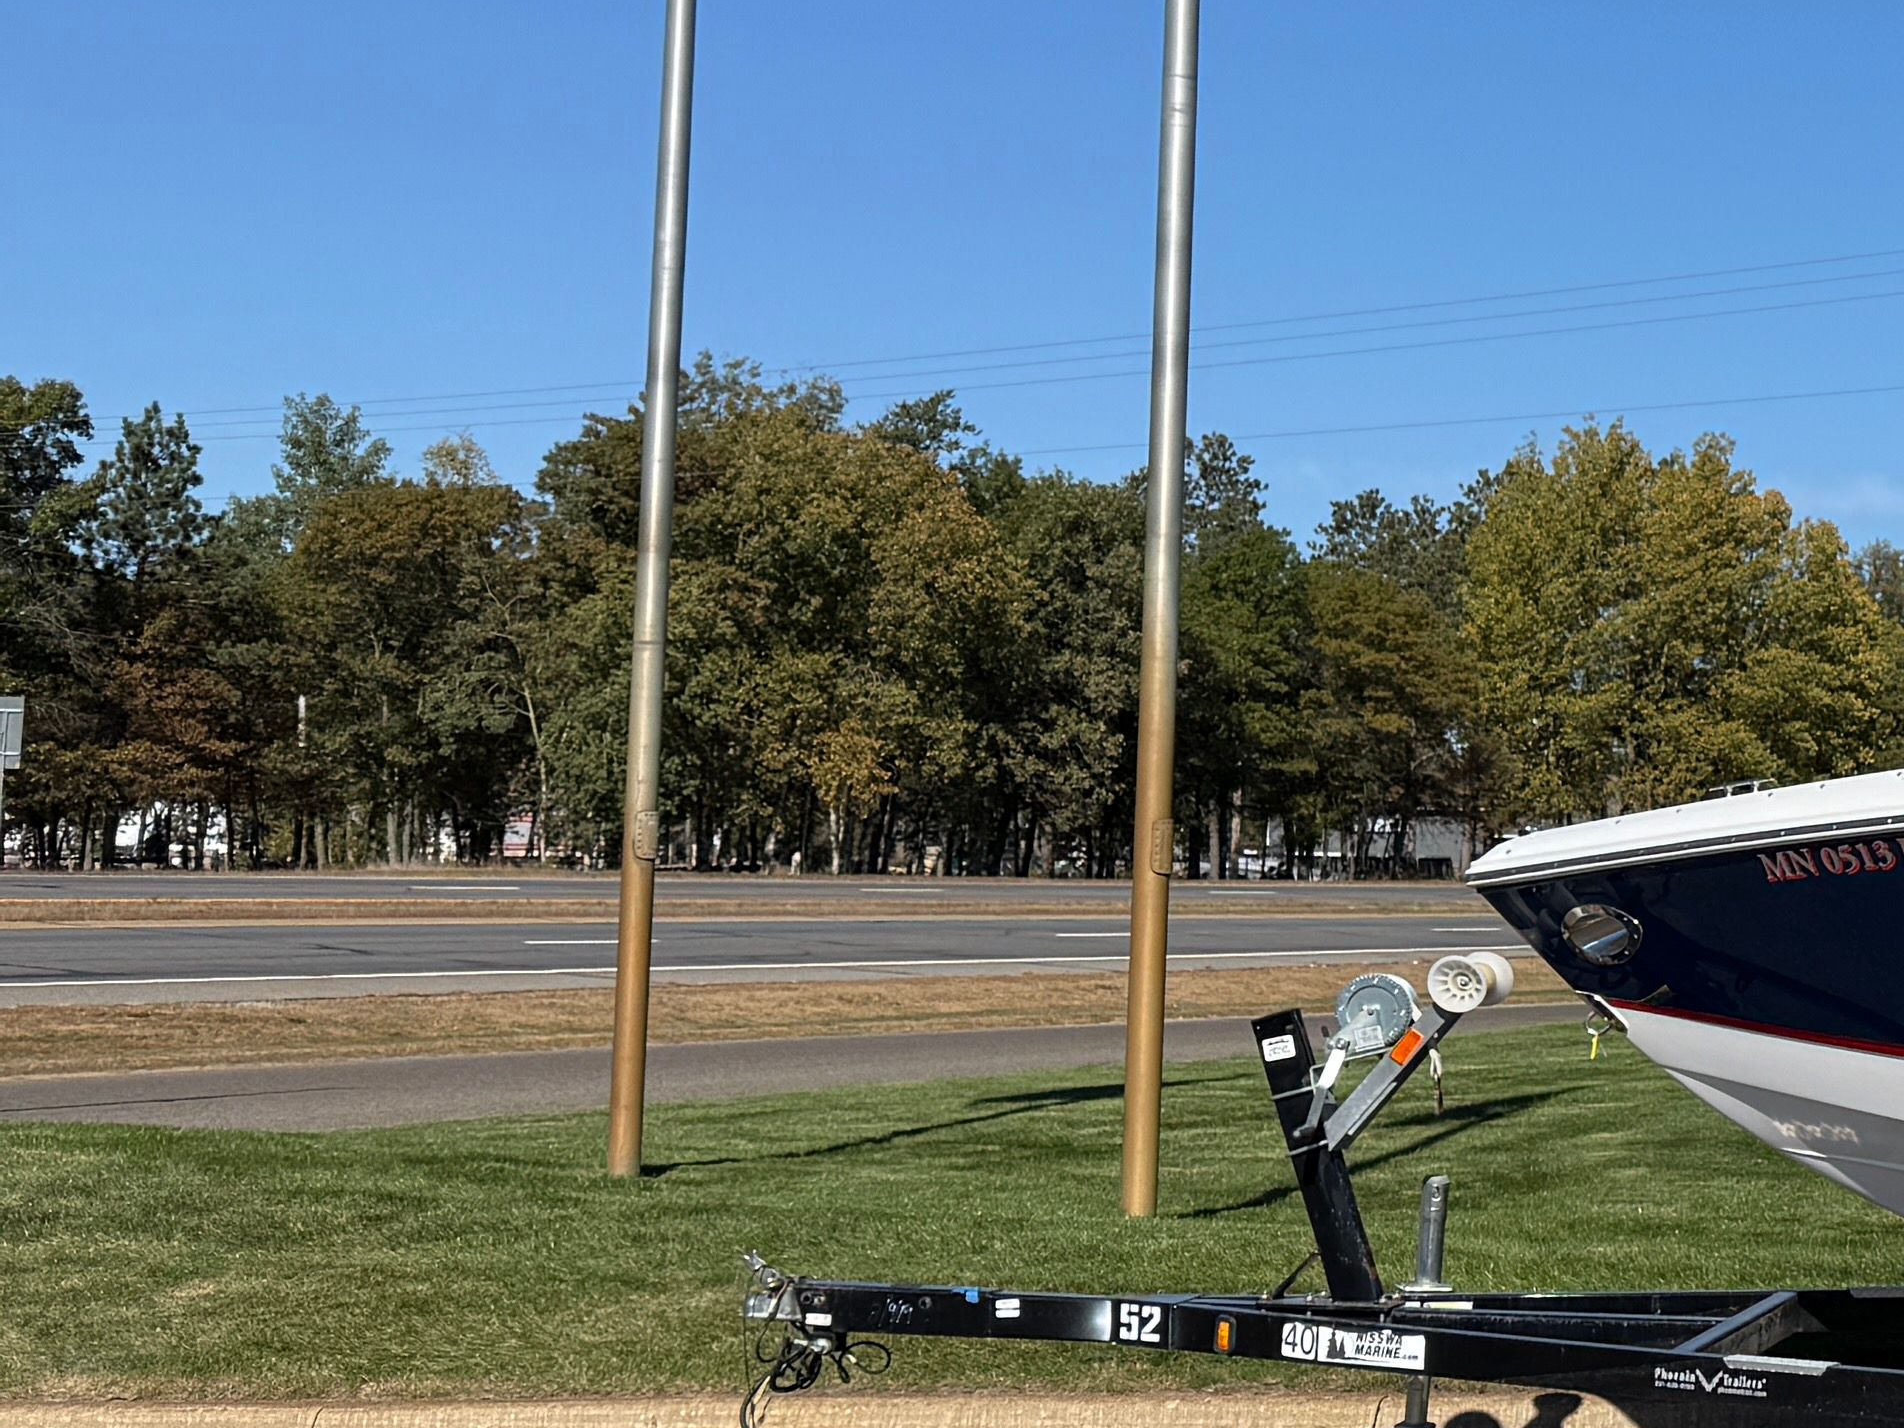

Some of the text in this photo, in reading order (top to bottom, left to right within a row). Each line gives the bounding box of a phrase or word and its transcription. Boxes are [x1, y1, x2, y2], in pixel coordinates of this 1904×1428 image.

[1757, 848, 1819, 883] MN
[1820, 840, 1897, 876] 0513
[1119, 1303, 1161, 1342] 52
[1284, 1323, 1315, 1355] 40
